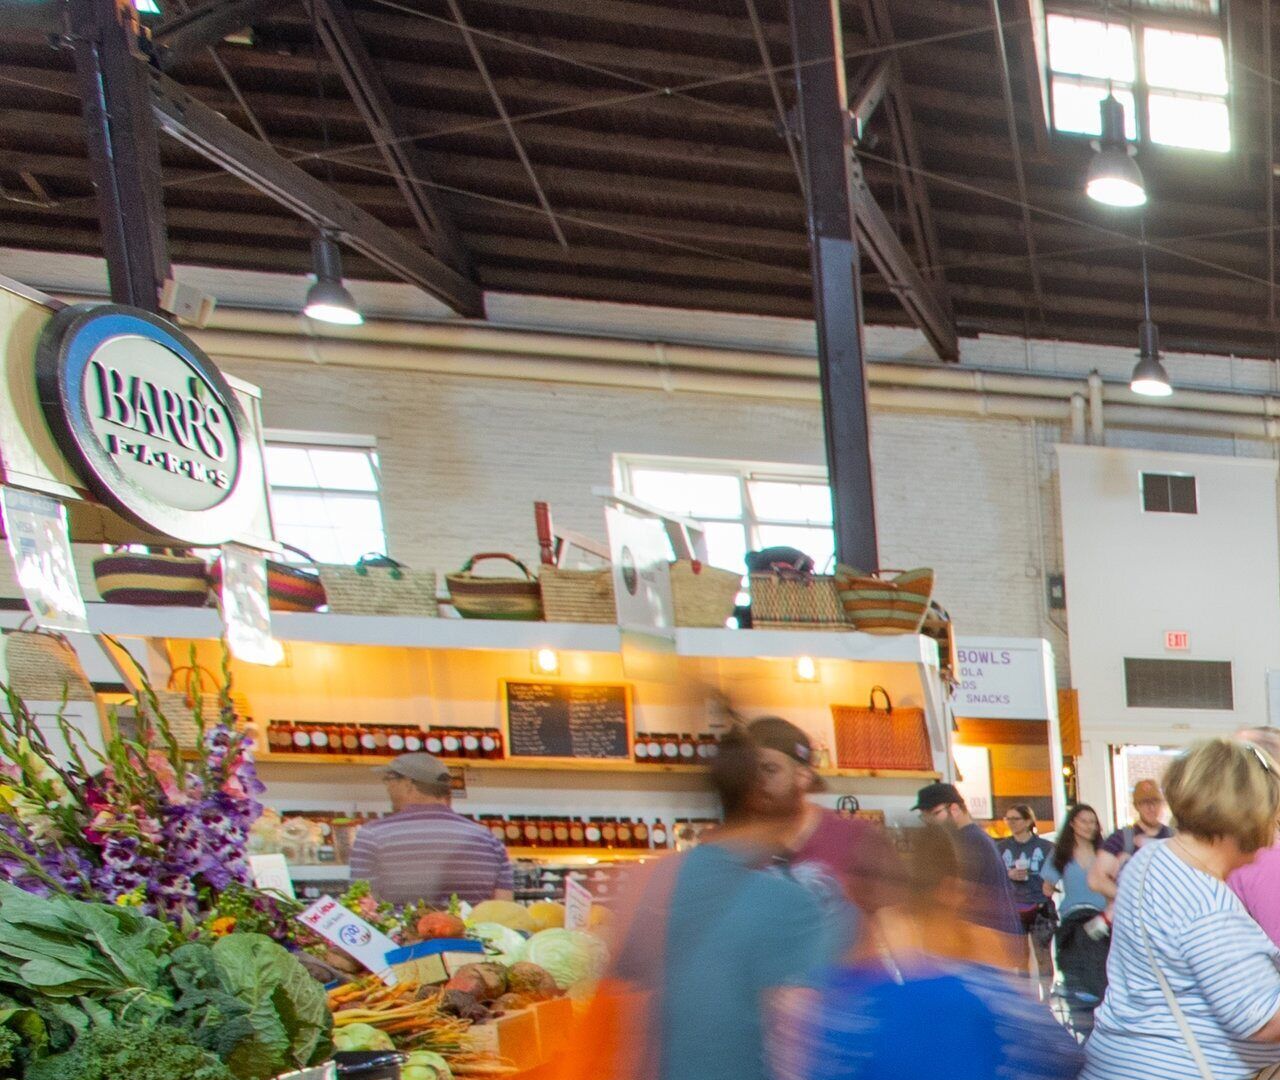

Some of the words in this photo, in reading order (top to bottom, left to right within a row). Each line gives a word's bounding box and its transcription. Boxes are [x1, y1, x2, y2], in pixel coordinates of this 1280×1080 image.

[1167, 632, 1188, 648] EXIT
[957, 651, 1011, 666] BOWLS
[961, 667, 983, 678] OLA
[966, 693, 1010, 704] SNACKS
